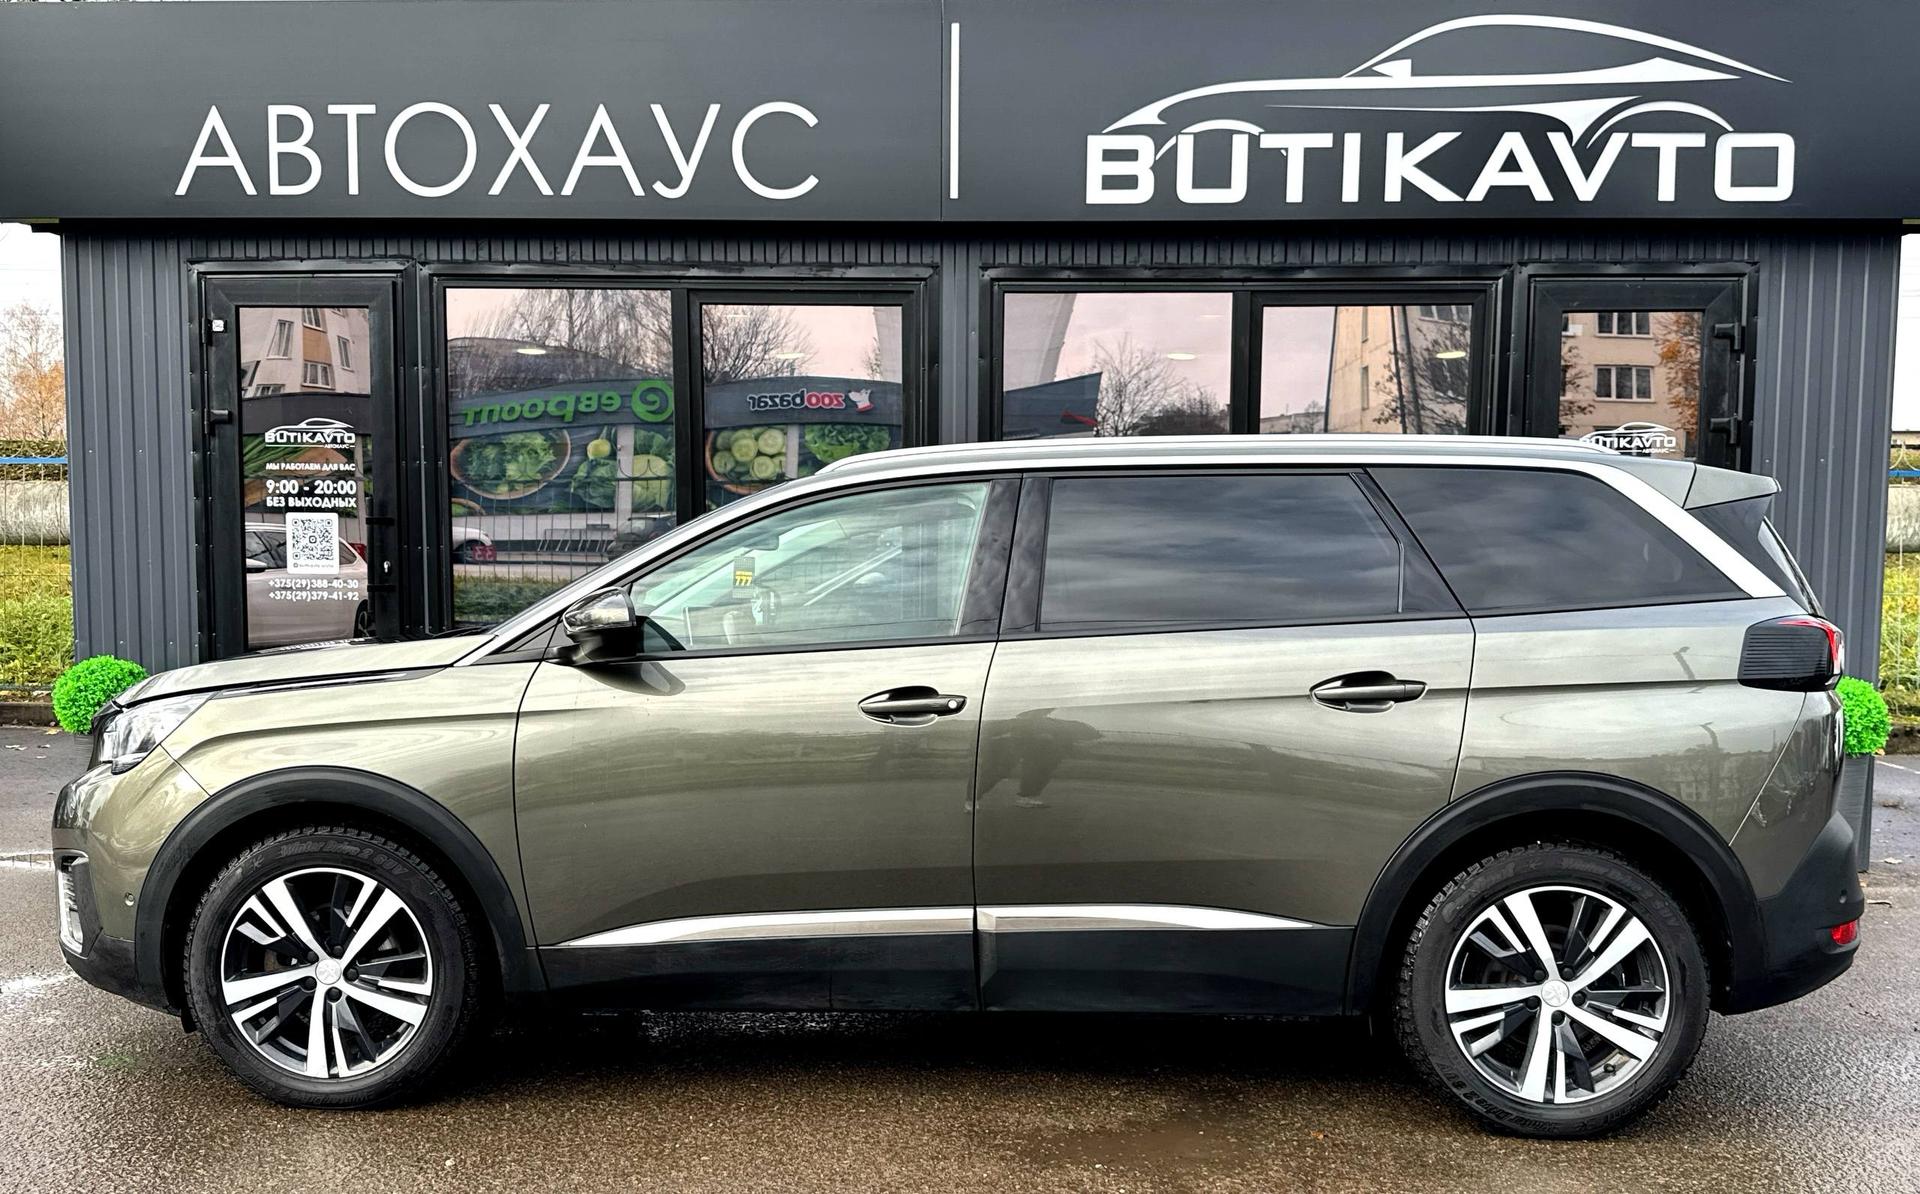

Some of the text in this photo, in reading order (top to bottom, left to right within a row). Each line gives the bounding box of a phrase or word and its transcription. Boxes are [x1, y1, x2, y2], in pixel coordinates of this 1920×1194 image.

[175, 101, 820, 200] АВТОХАУС
[1086, 132, 1796, 205] BUTIKAVTO
[265, 431, 356, 443] BUTIKAVTO
[265, 462, 356, 472] МЫ РАБОТАЕМ ДЛЯ ВАС
[265, 479, 300, 495] 9:00
[313, 479, 357, 495] 20:00
[266, 496, 357, 508] БЕЗ ВЫХОДНЫХ
[268, 579, 359, 591] +375(29)388-40-30
[268, 591, 360, 602] +375(29)379-41-92
